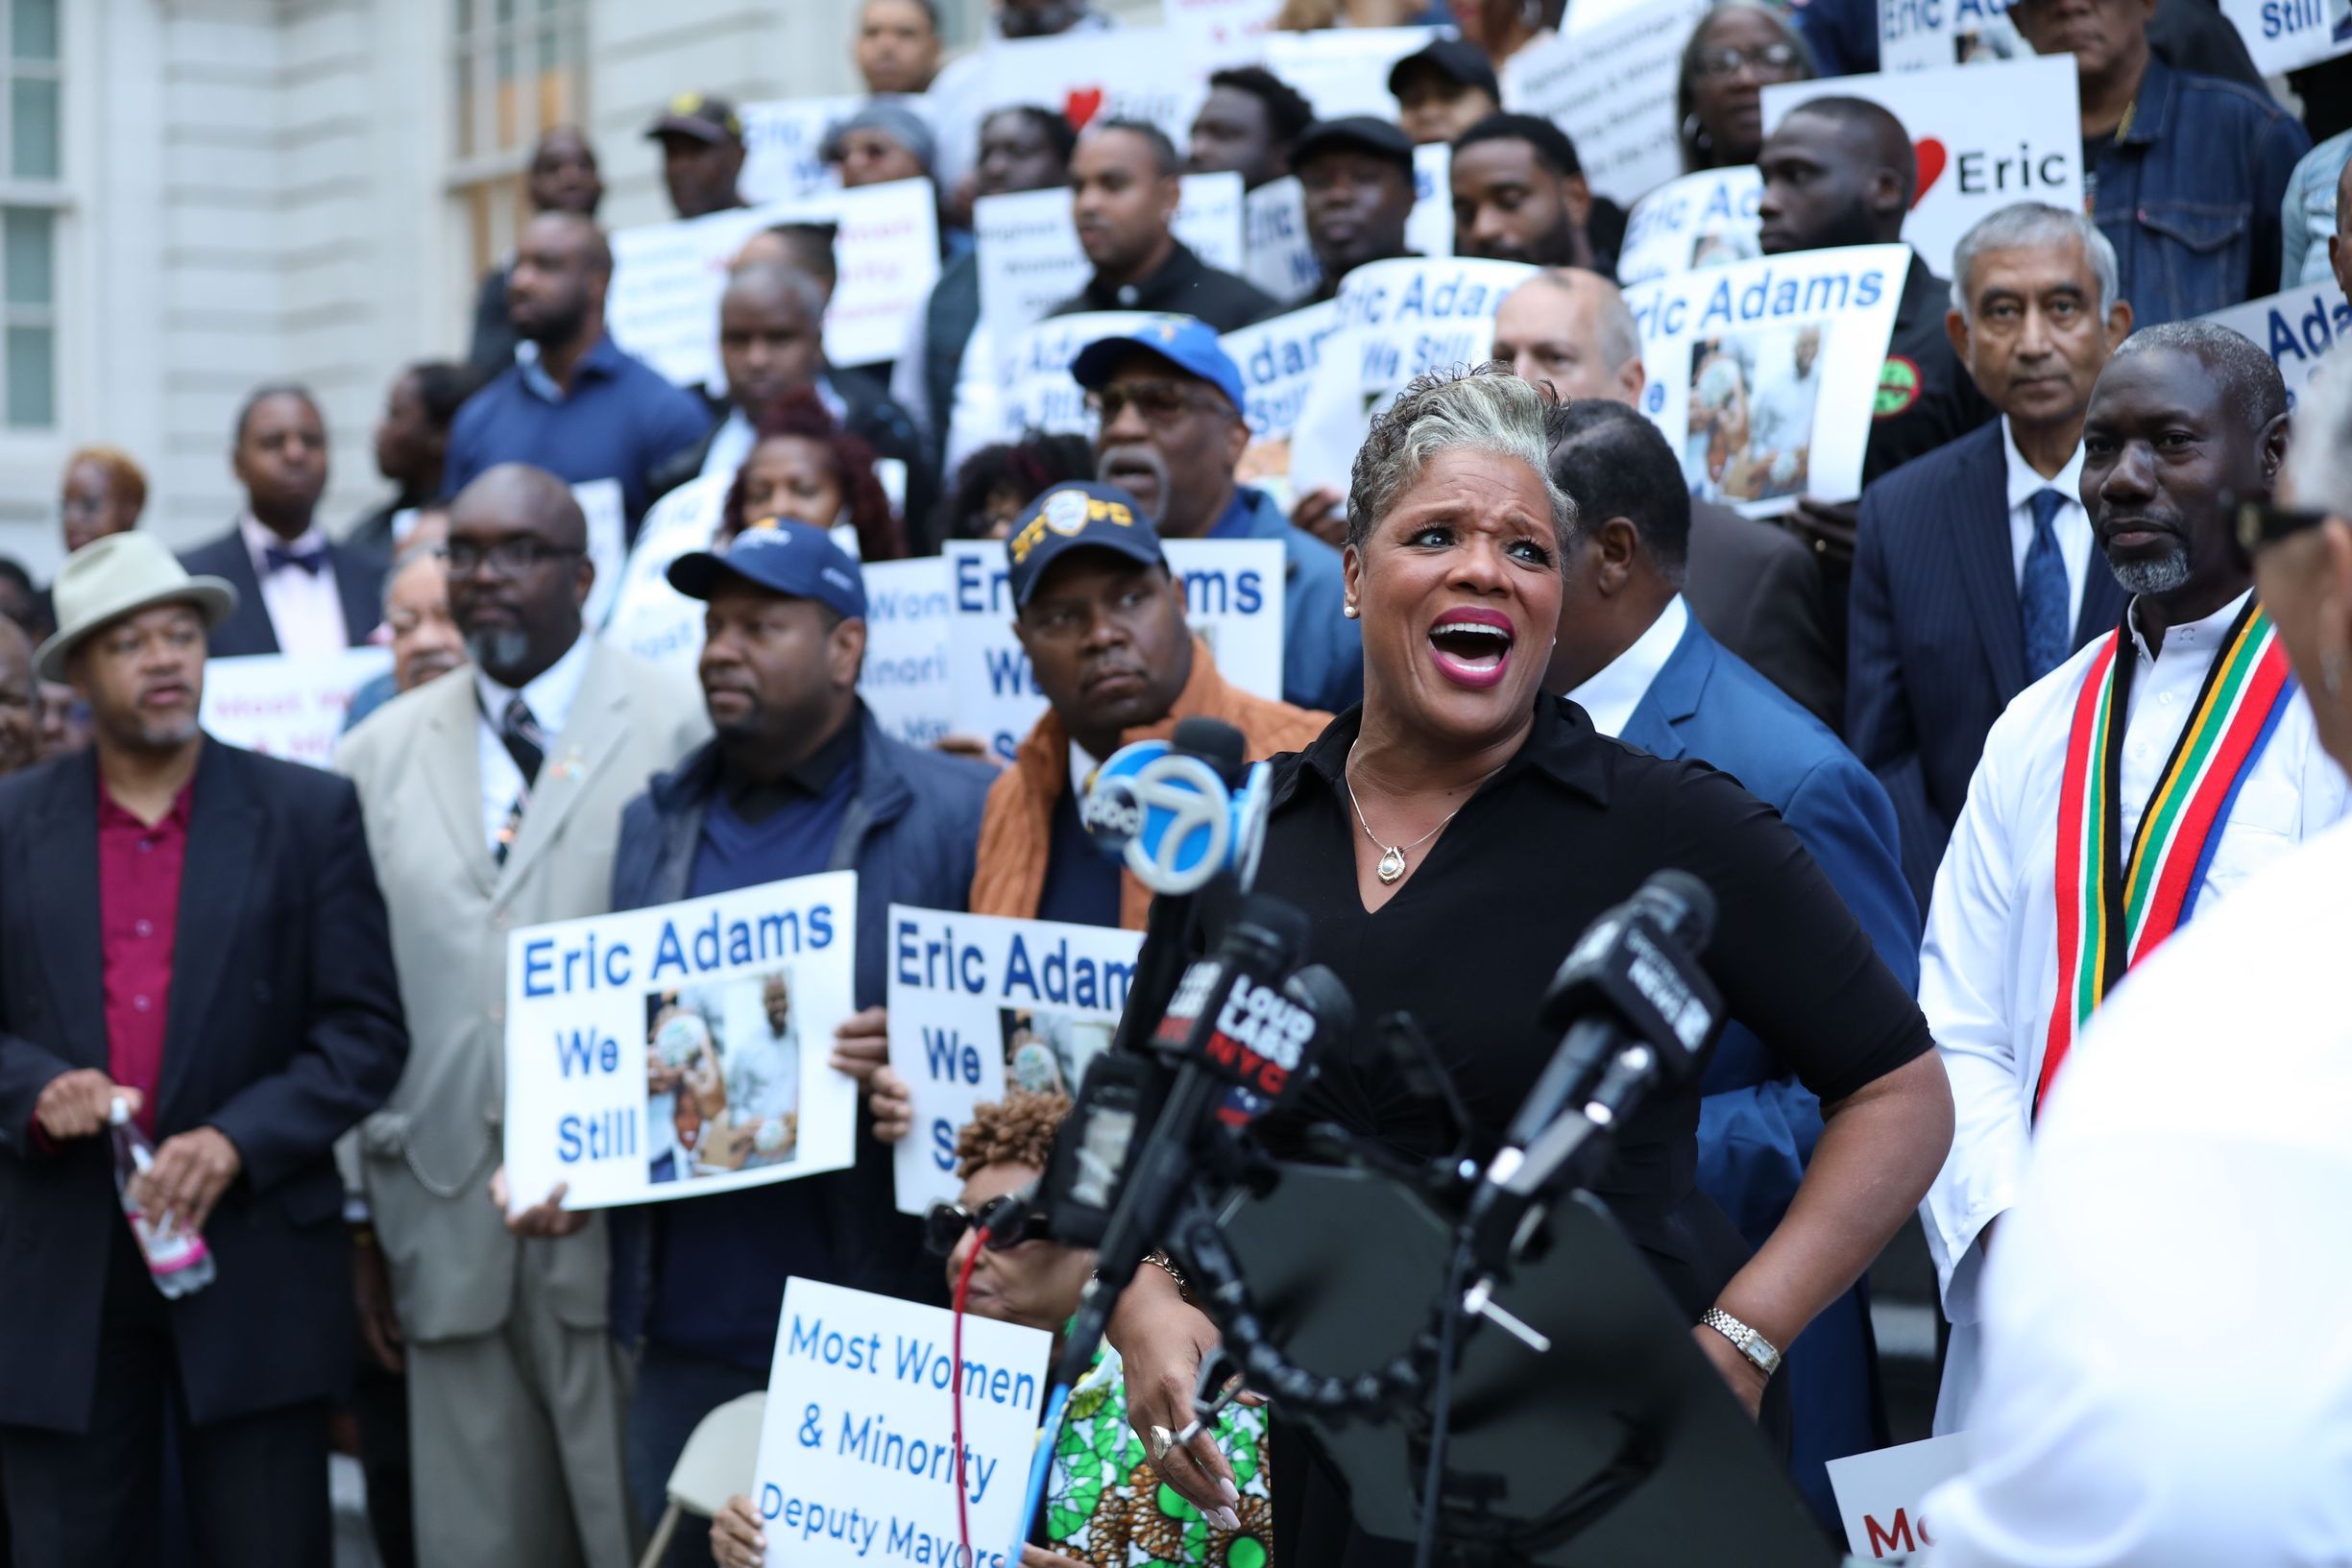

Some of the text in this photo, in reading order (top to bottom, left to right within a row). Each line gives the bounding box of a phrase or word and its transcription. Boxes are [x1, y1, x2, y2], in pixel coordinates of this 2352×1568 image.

[1957, 142, 2067, 194] Eric
[1636, 269, 1884, 338] ric Adams
[2267, 293, 2352, 367] Ada
[523, 905, 834, 999] Eric Adams
[897, 920, 986, 995] Eric
[1002, 932, 1138, 1012] Adam
[1216, 1002, 1304, 1072] LABS
[1229, 974, 1316, 1046] LOUD
[555, 1027, 619, 1077] We
[922, 1025, 982, 1085] We
[1204, 1029, 1289, 1096] NYC
[559, 1109, 636, 1164] Still
[788, 1314, 1035, 1411] Most Women
[797, 1403, 998, 1504] & Minority
[759, 1483, 878, 1556] Deputy
